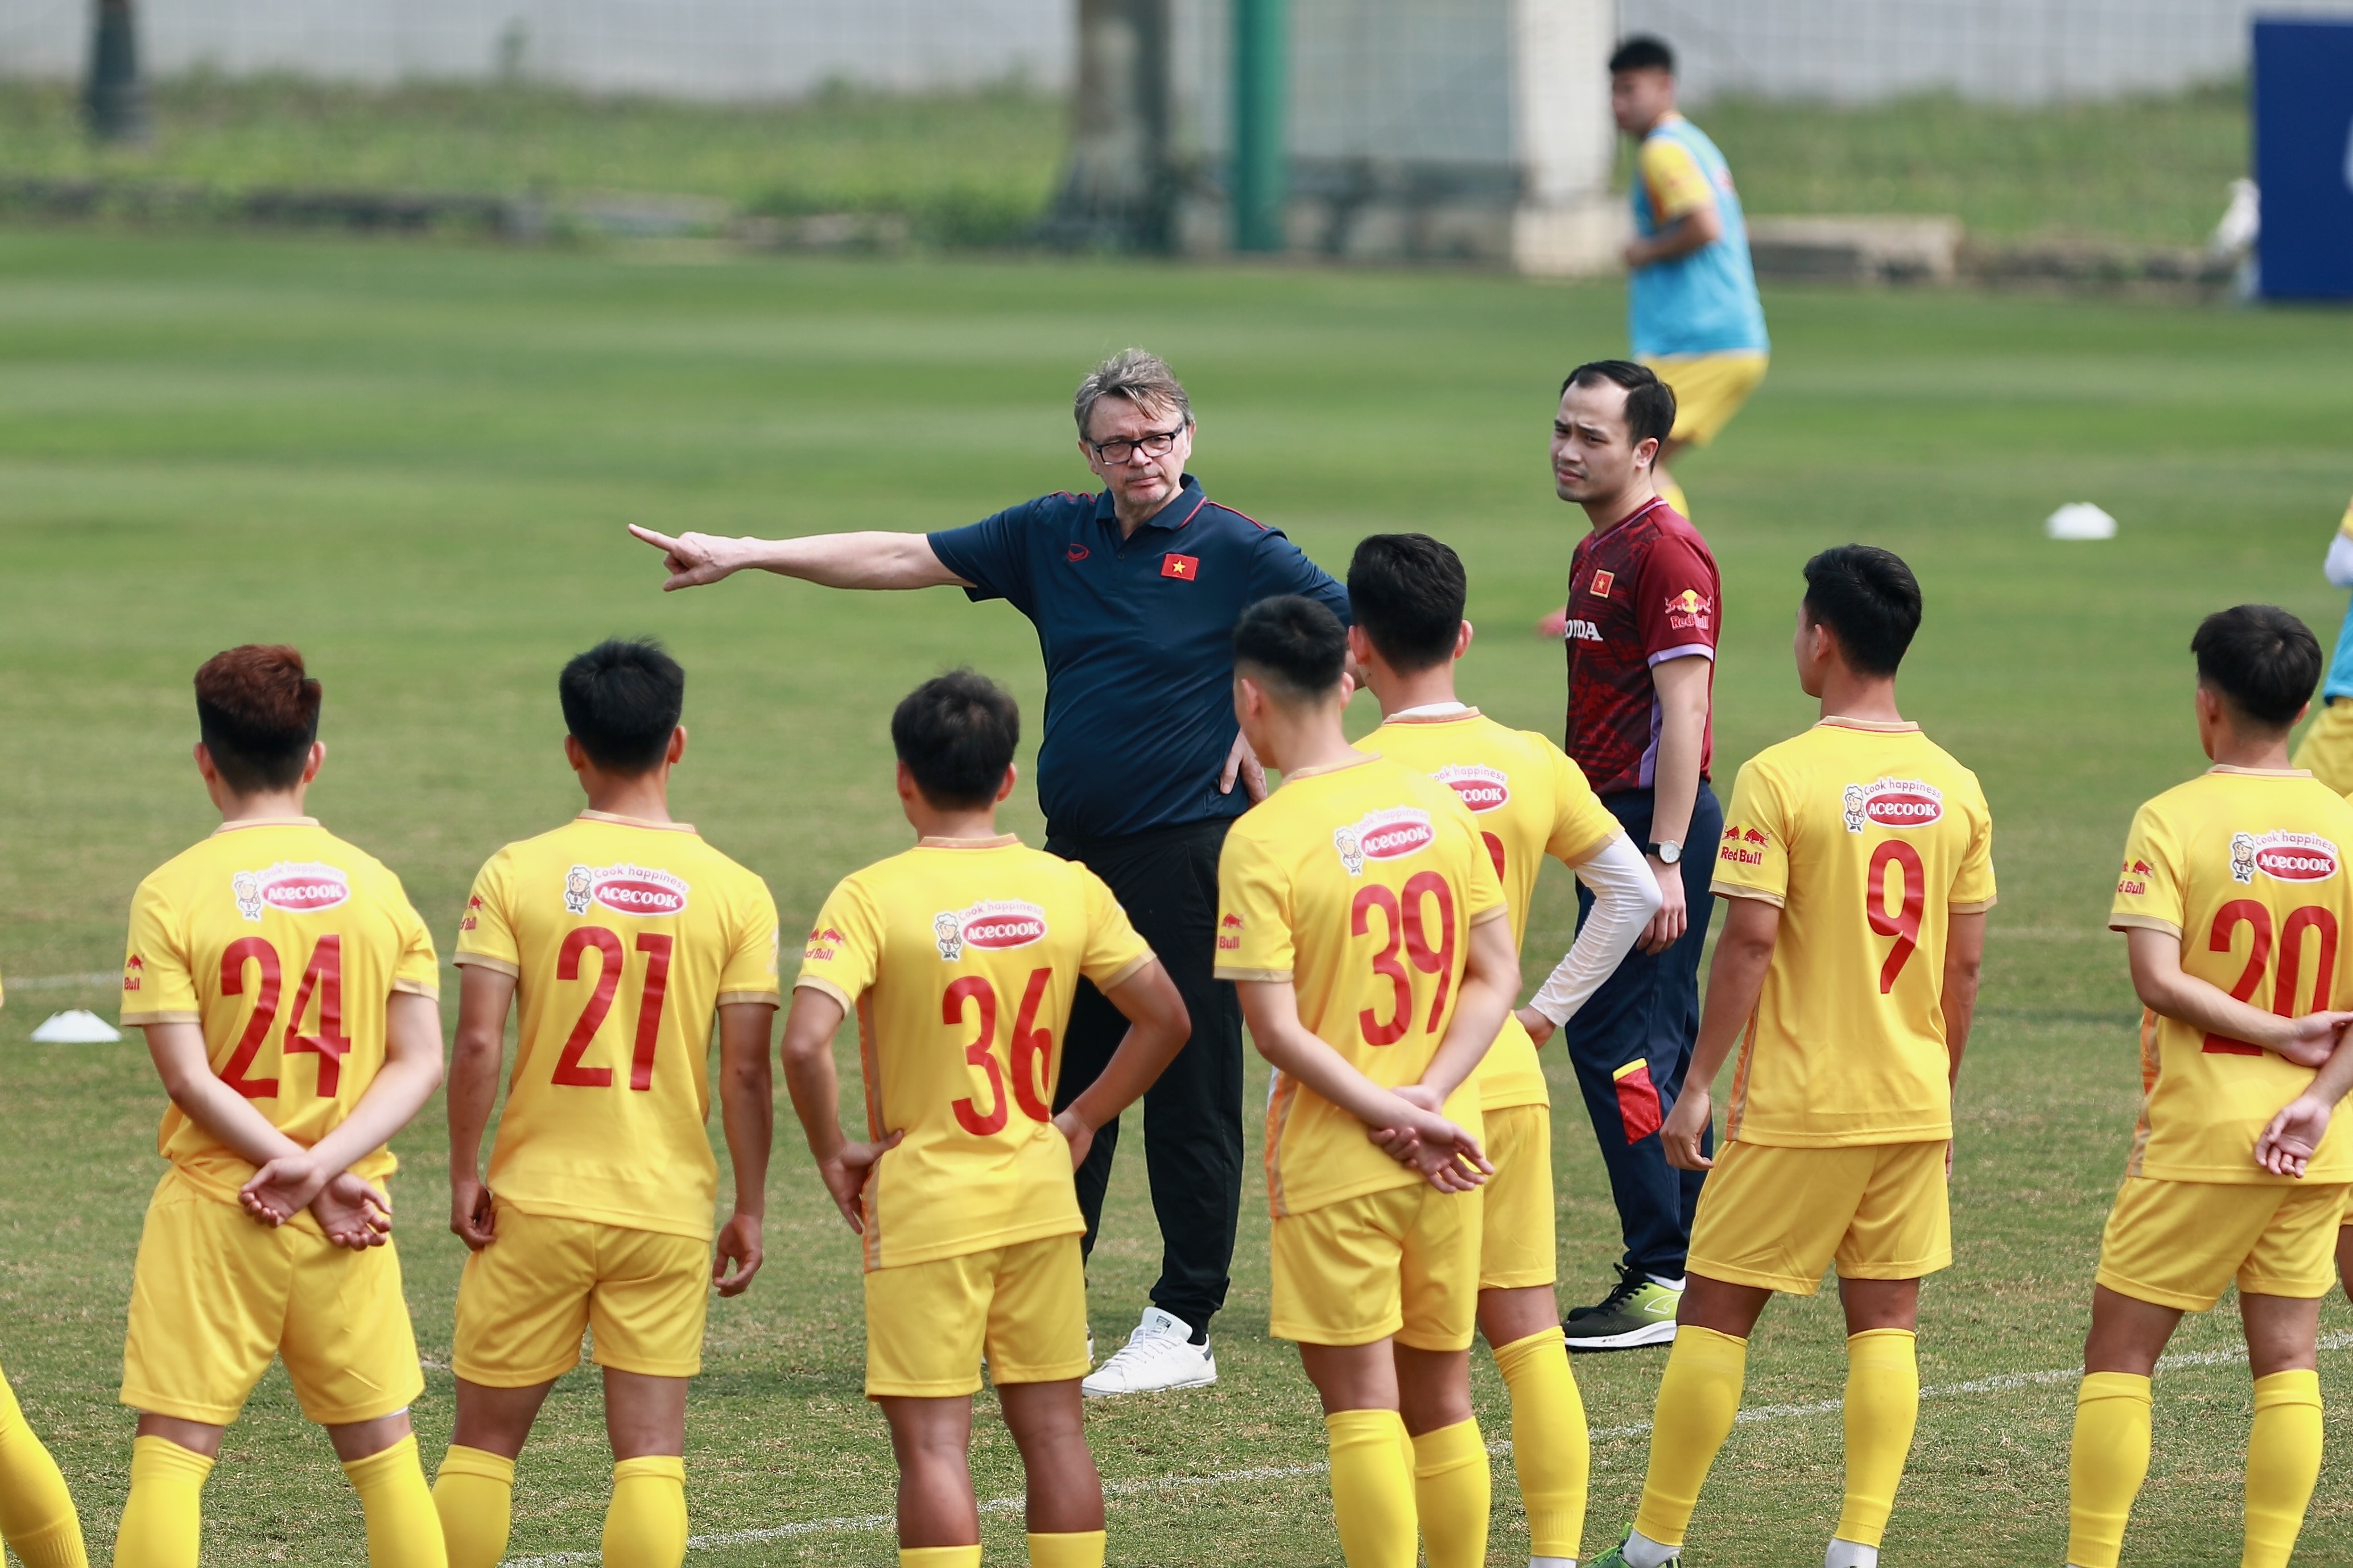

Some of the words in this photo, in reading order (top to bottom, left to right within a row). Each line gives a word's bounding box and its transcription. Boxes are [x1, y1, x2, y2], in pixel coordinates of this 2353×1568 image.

[1670, 614, 1694, 630] Red
[1430, 768, 1451, 781] ook
[1454, 766, 1505, 781] happiness
[1864, 780, 1886, 796] Cook
[1889, 779, 1941, 799] happiness
[1353, 814, 1374, 834] Cook
[1376, 806, 1429, 821] happiness
[2256, 833, 2279, 845] Cook
[2282, 831, 2337, 853] happiness
[1720, 846, 1739, 861] Red
[1739, 849, 1762, 865] Bull
[287, 863, 344, 879] happiness
[595, 865, 624, 878] Cook
[628, 865, 687, 892] happiness
[2124, 881, 2145, 895] Bull
[958, 903, 984, 921] Cook
[987, 901, 1043, 916] happiness
[1867, 839, 1925, 995] 9
[1219, 936, 1239, 949] Bull
[814, 948, 833, 961] Bull
[1351, 871, 1454, 1046] 39
[125, 977, 140, 990] Bull
[2202, 899, 2337, 1057] 20
[220, 934, 350, 1098] 24
[551, 926, 673, 1091] 21
[942, 967, 1052, 1136] 36
